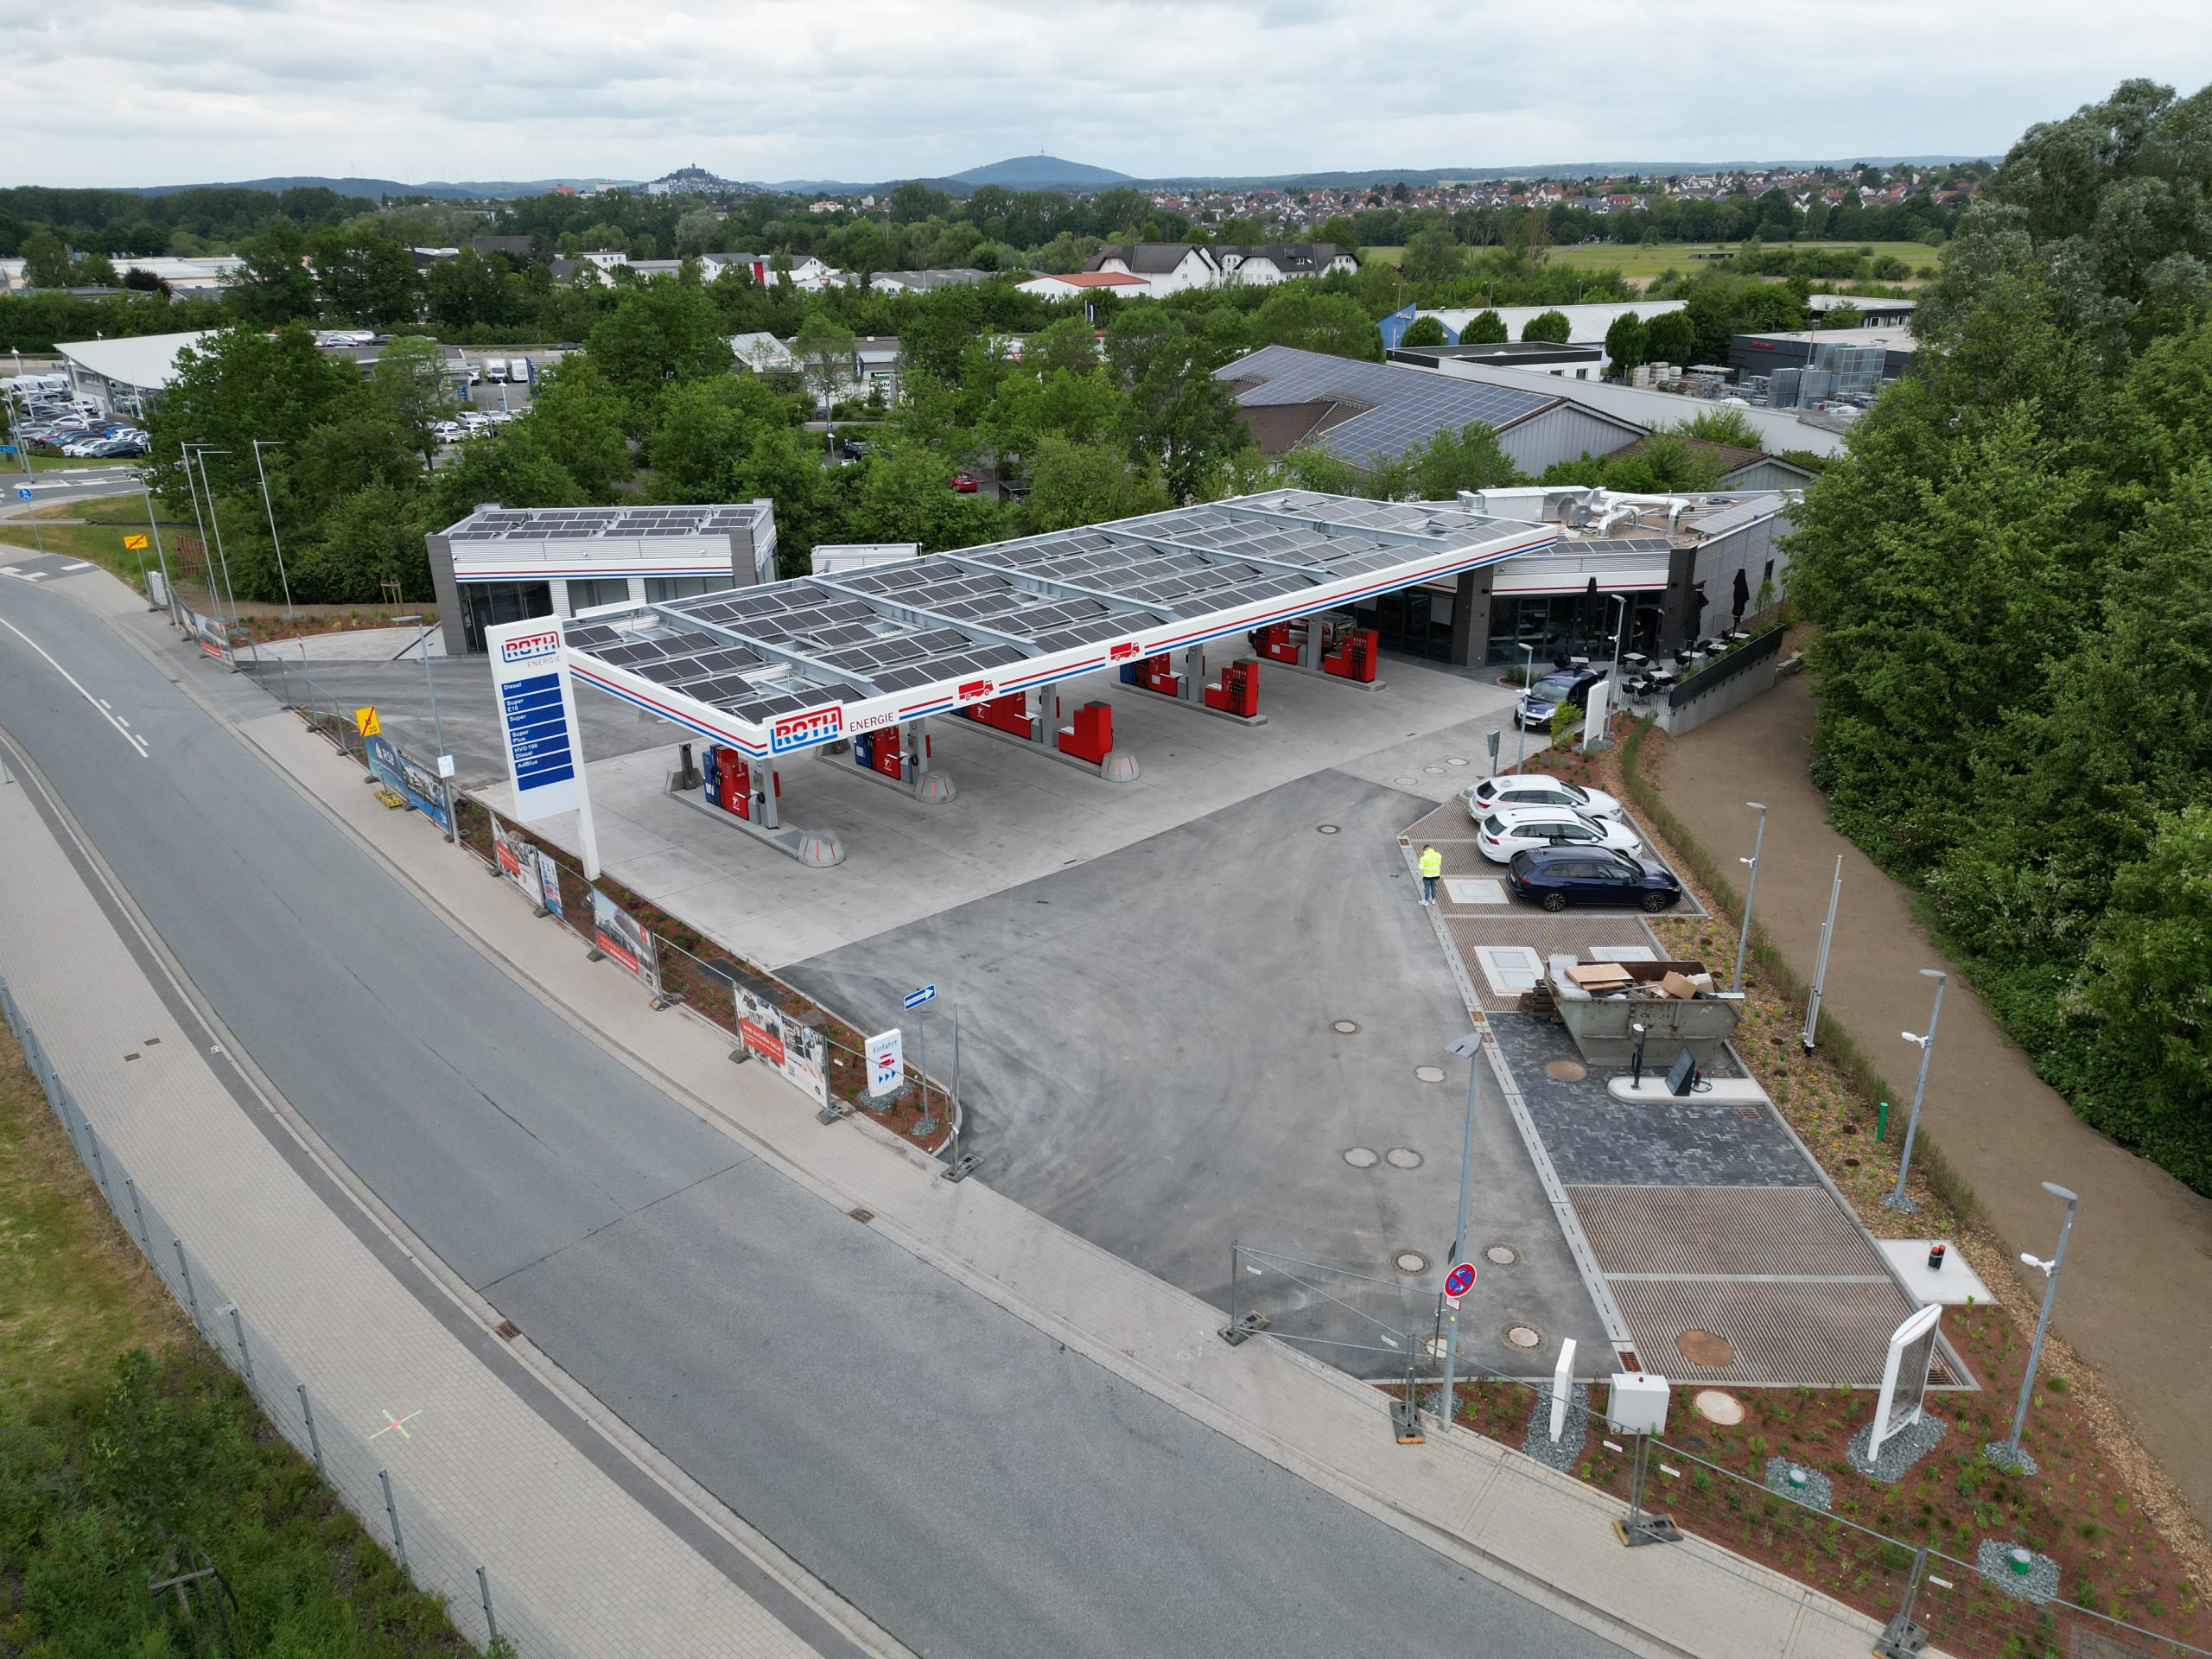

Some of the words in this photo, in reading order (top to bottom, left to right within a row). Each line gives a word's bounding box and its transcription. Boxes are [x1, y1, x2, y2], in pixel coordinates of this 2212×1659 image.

[505, 635, 555, 658] ROTH
[527, 656, 561, 668] ENERGIE
[506, 698, 524, 707] Super
[509, 714, 526, 722] Super
[776, 713, 837, 747] ROTH
[849, 712, 894, 732] ENERGIE
[873, 1039, 898, 1054] Einfahrt
